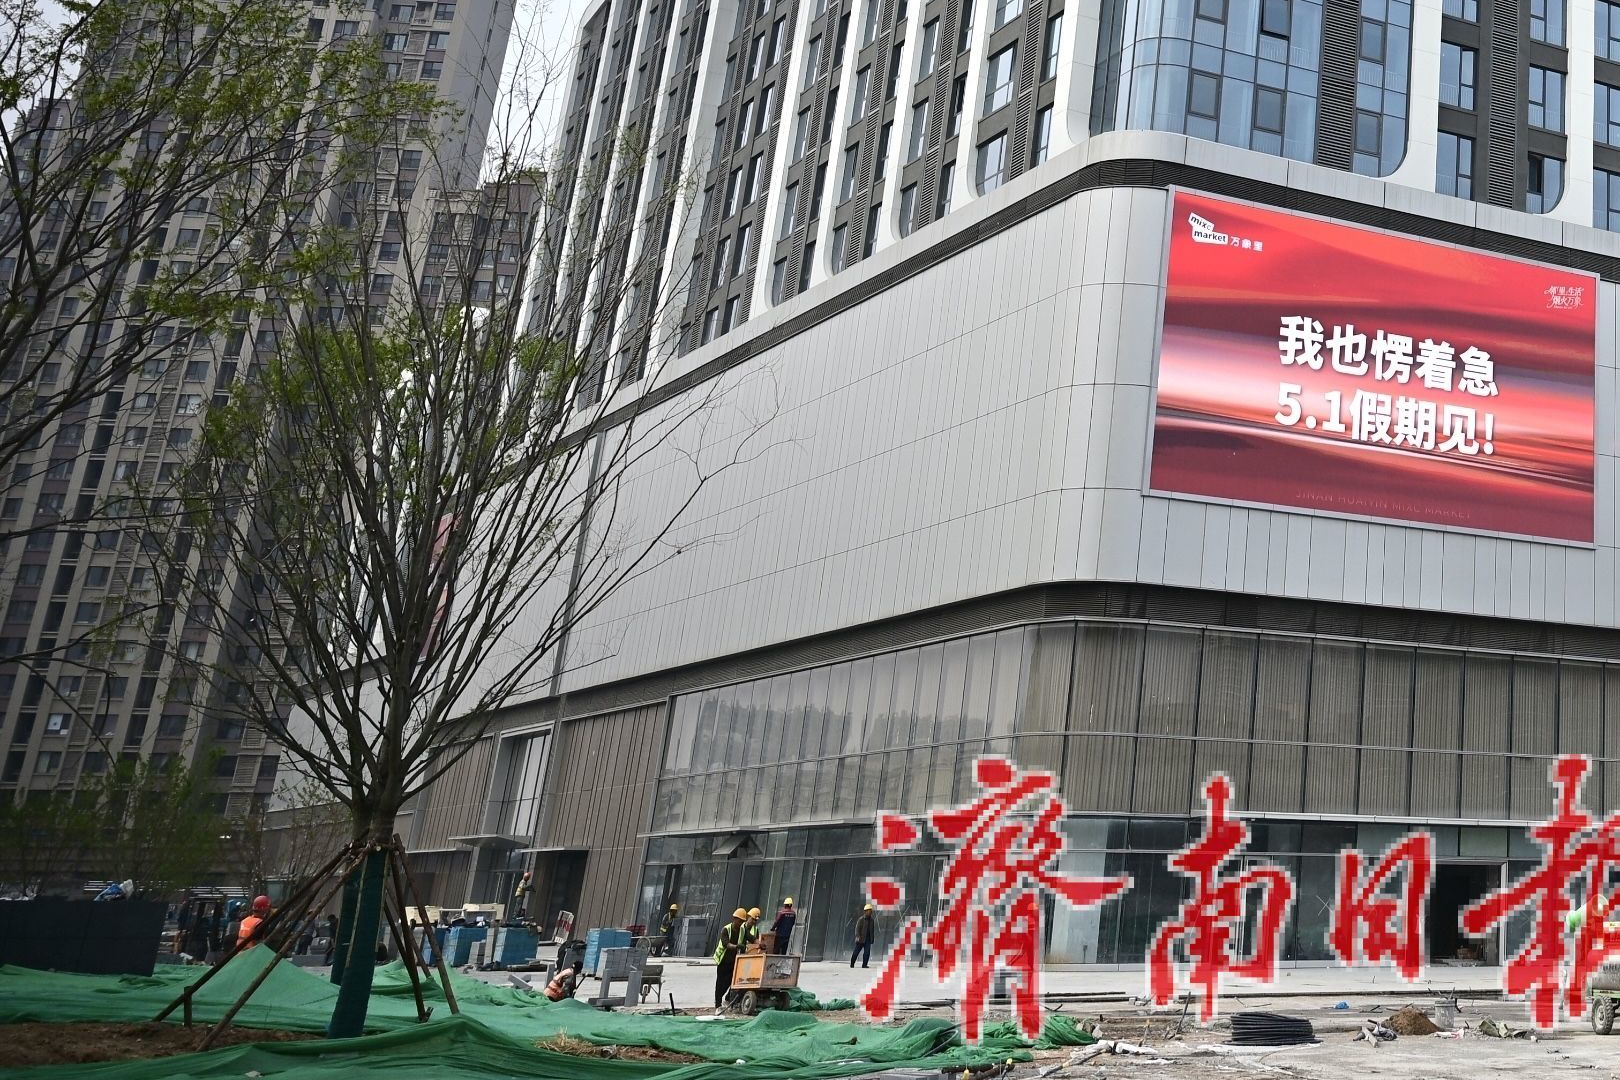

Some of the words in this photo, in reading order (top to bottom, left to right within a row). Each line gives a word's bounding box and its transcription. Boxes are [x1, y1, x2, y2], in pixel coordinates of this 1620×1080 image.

[1194, 230, 1226, 242] market
[1278, 315, 1499, 398] 我也愣着急
